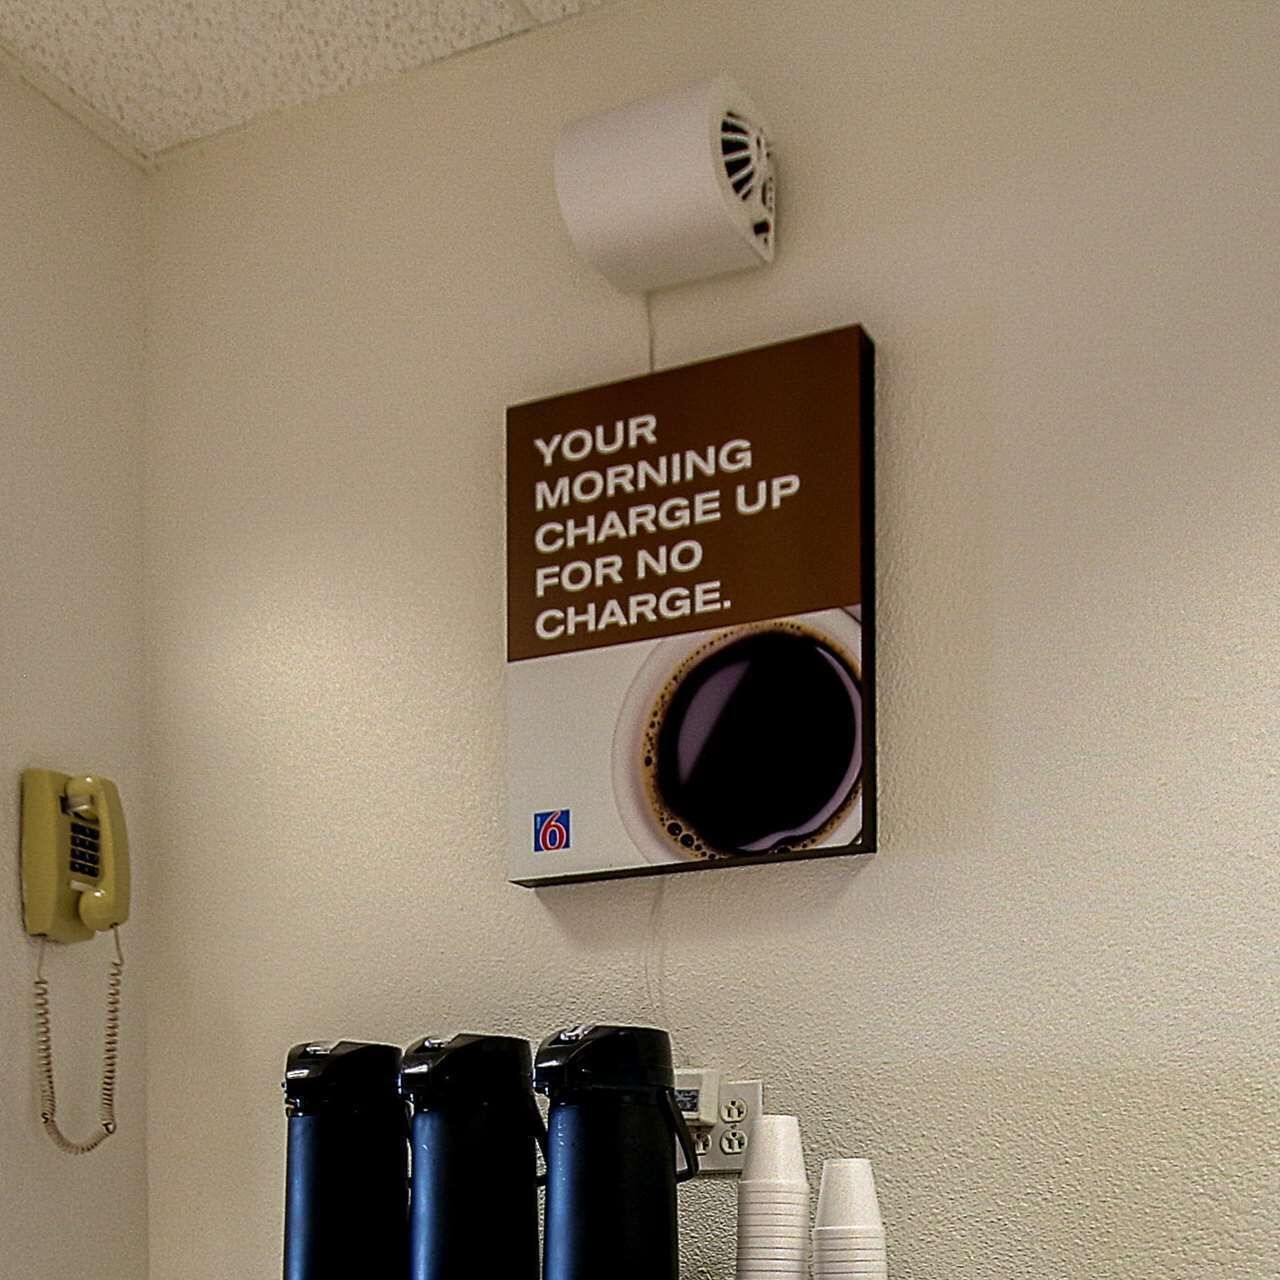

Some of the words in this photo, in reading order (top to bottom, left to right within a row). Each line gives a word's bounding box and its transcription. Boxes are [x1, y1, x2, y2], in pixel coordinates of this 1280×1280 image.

[533, 414, 657, 466] YOUR
[534, 439, 752, 511] MORNING
[534, 490, 721, 553] CHARGE
[735, 474, 800, 515] UP
[535, 555, 623, 598] FOR
[637, 540, 703, 579] NO
[534, 580, 732, 640] CHARGE.
[539, 810, 567, 852] 6
